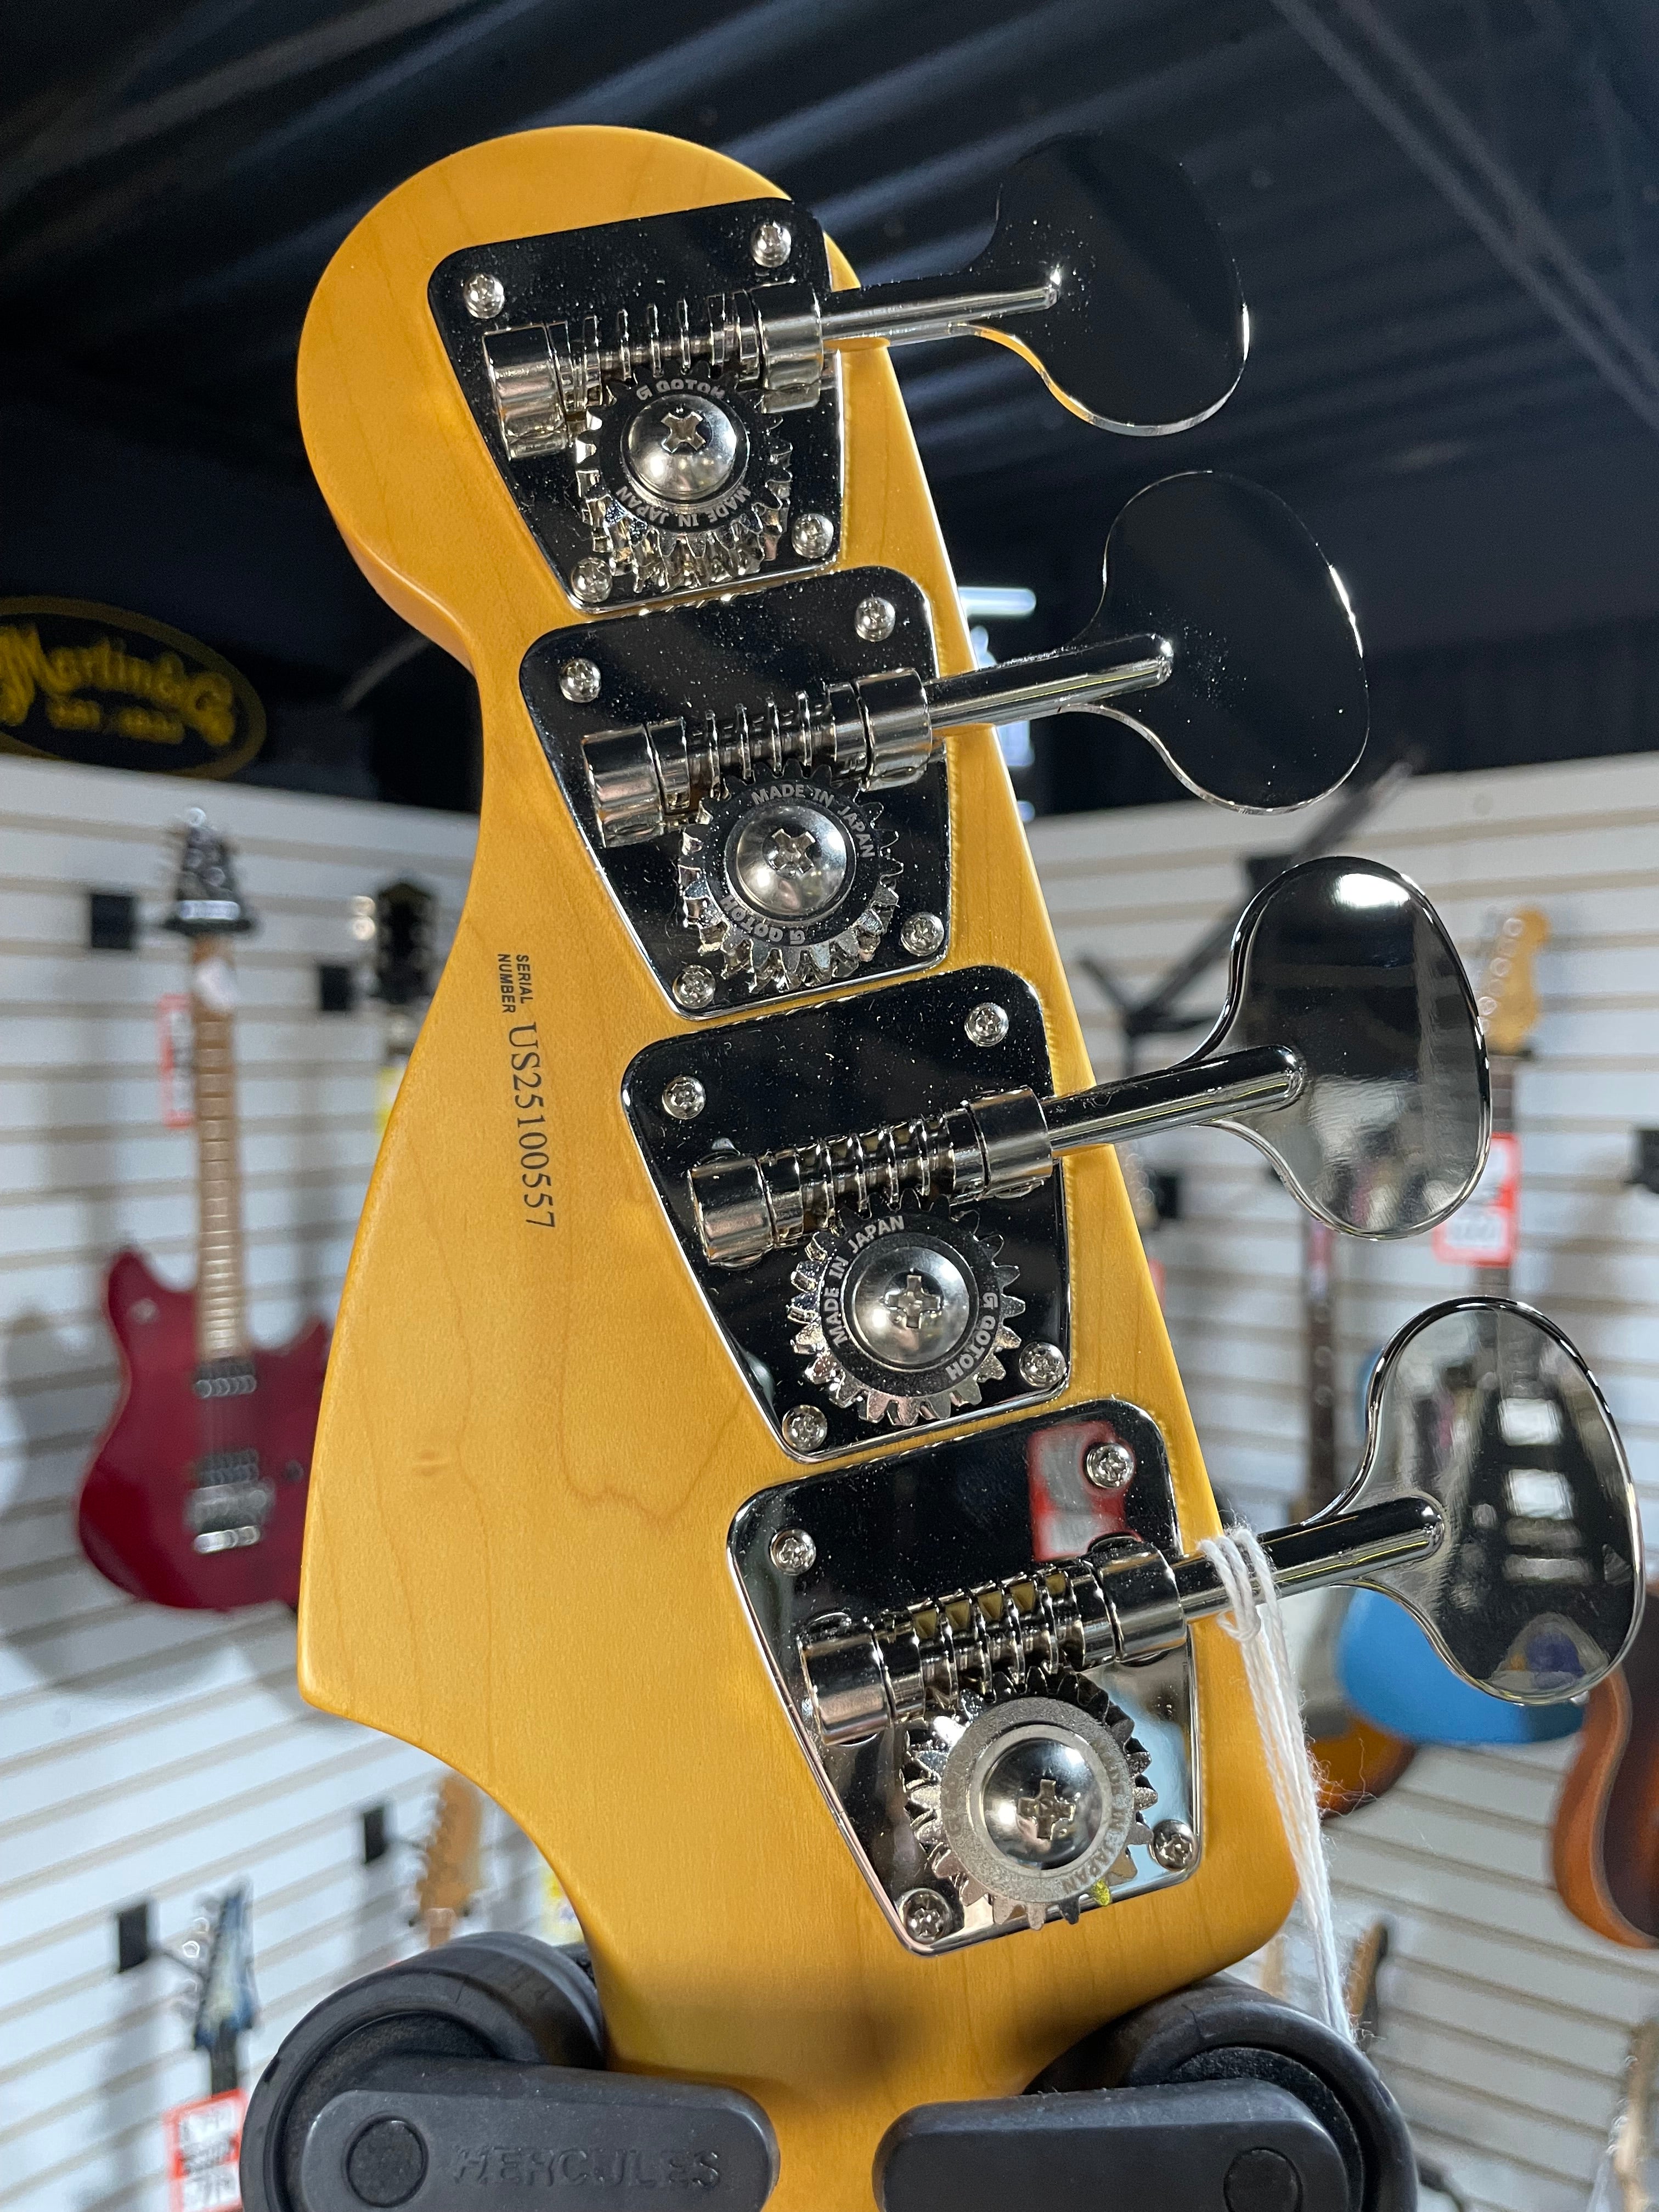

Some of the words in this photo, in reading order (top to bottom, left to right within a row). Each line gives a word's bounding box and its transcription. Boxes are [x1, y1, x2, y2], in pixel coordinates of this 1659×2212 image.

[616, 486, 667, 524] JAPAN
[678, 514, 699, 527] IN
[710, 486, 751, 523] MADE
[751, 783, 806, 805] MADE
[812, 788, 834, 806] IN
[837, 806, 875, 858] JAPAN
[498, 953, 516, 1013] NUMBER
[516, 954, 533, 1004] SERIAL
[509, 1022, 556, 1228] US25100557
[848, 1215, 904, 1254] JAPAN
[829, 1256, 850, 1283] IN
[824, 1287, 848, 1346] MADE
[452, 2144, 722, 2188] HERCULES
